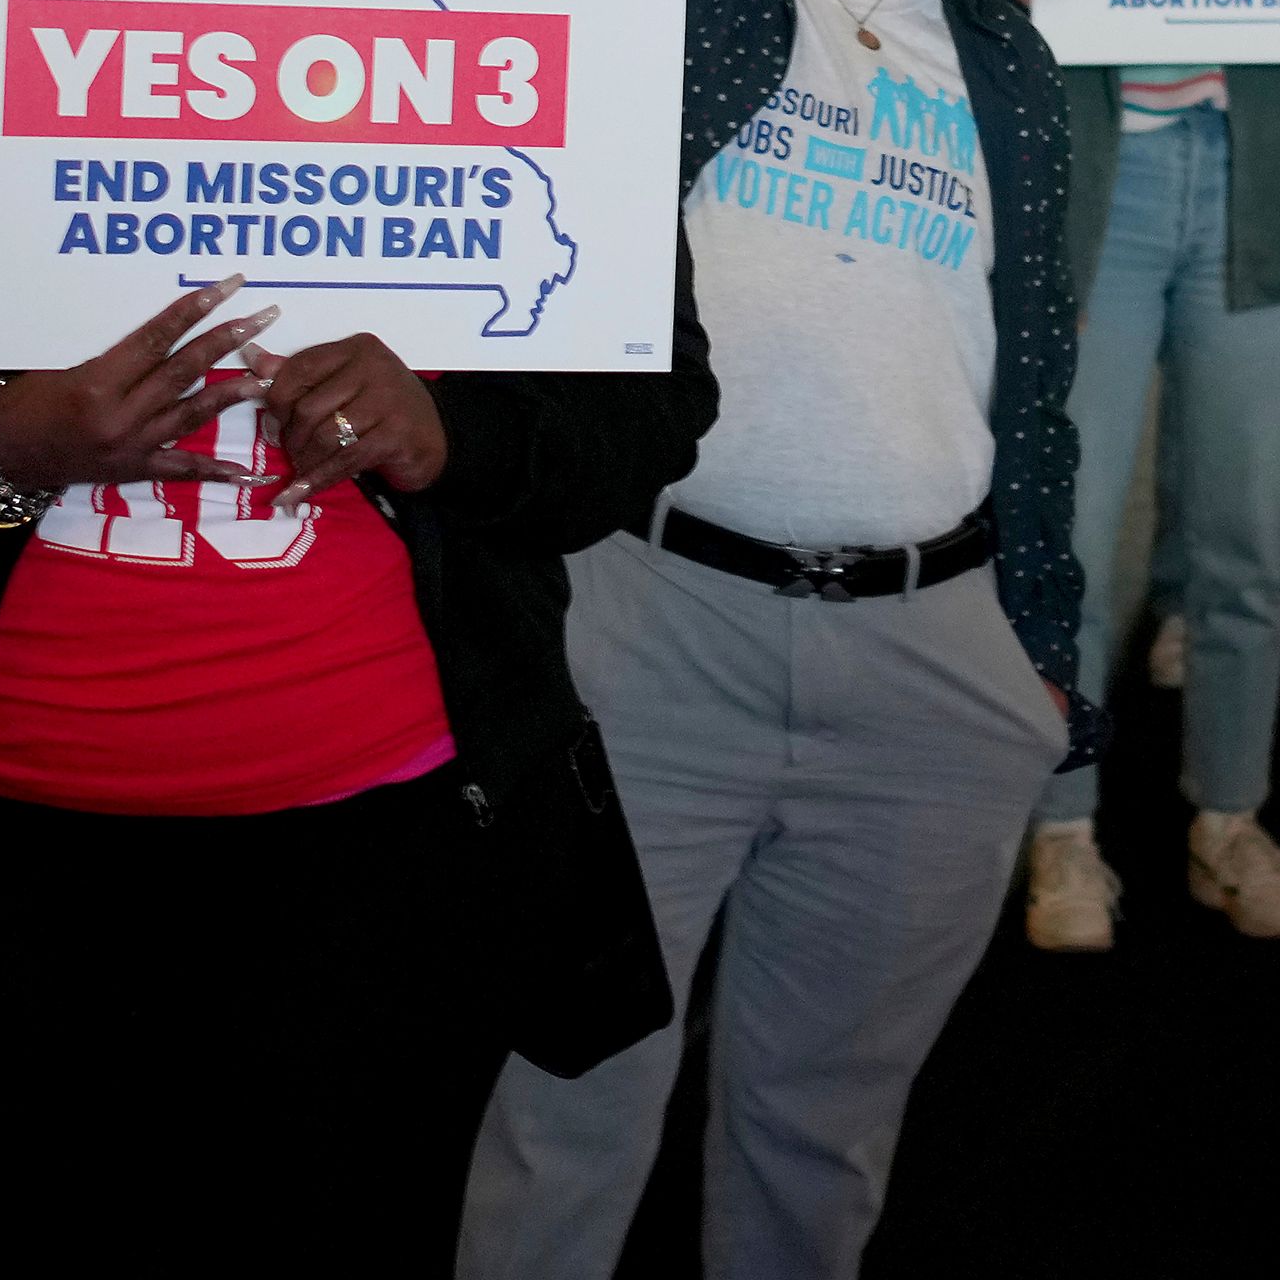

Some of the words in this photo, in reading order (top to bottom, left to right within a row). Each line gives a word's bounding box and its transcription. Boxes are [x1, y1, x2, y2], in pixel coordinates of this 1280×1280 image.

[31, 27, 257, 122] YES
[276, 34, 456, 126] ON
[475, 36, 540, 128] 3
[766, 88, 859, 136] SSOURI
[54, 160, 169, 204] END
[185, 161, 513, 209] MISSOURI'S
[737, 119, 793, 160] OBS
[870, 153, 977, 219] JUSTICE
[59, 213, 364, 259] ABORTION
[382, 217, 501, 261] BAN
[715, 153, 835, 231] VOTER
[844, 190, 976, 271] ACTION
